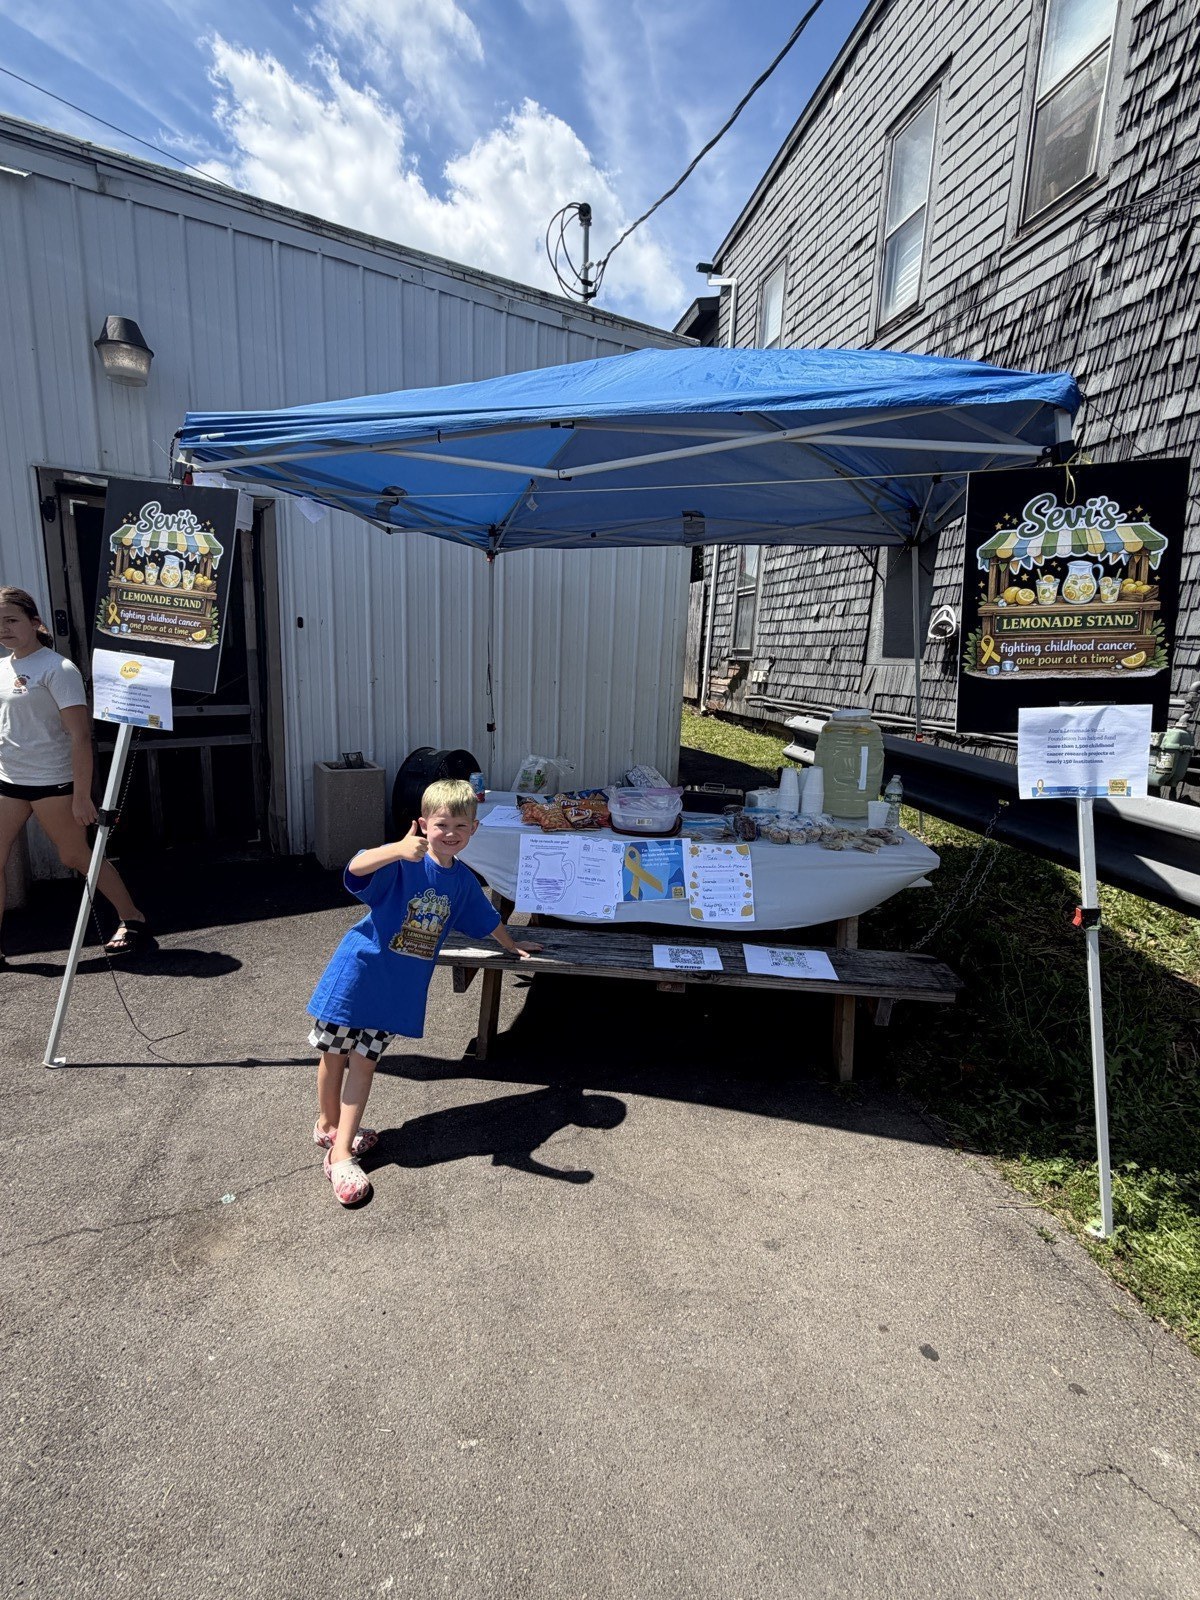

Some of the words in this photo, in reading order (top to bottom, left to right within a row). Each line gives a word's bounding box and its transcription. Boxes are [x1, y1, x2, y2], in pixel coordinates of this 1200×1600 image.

[136, 501, 201, 535] Sevi's
[1016, 492, 1127, 540] Sevi's
[122, 590, 172, 606] LEMONADE
[173, 597, 202, 609] STAND
[120, 609, 146, 627] fighting
[147, 612, 178, 627] childhood
[1002, 615, 1083, 630] LEMONADE
[1086, 614, 1134, 627] STAND
[129, 622, 141, 631] one
[142, 624, 157, 634] pour
[159, 625, 167, 634] at
[1000, 641, 1041, 657] fighting
[1044, 639, 1095, 652] childhood
[1016, 657, 1035, 665] one
[1038, 657, 1062, 667] pour
[1065, 655, 1077, 664] at
[1091, 653, 1118, 664] time.
